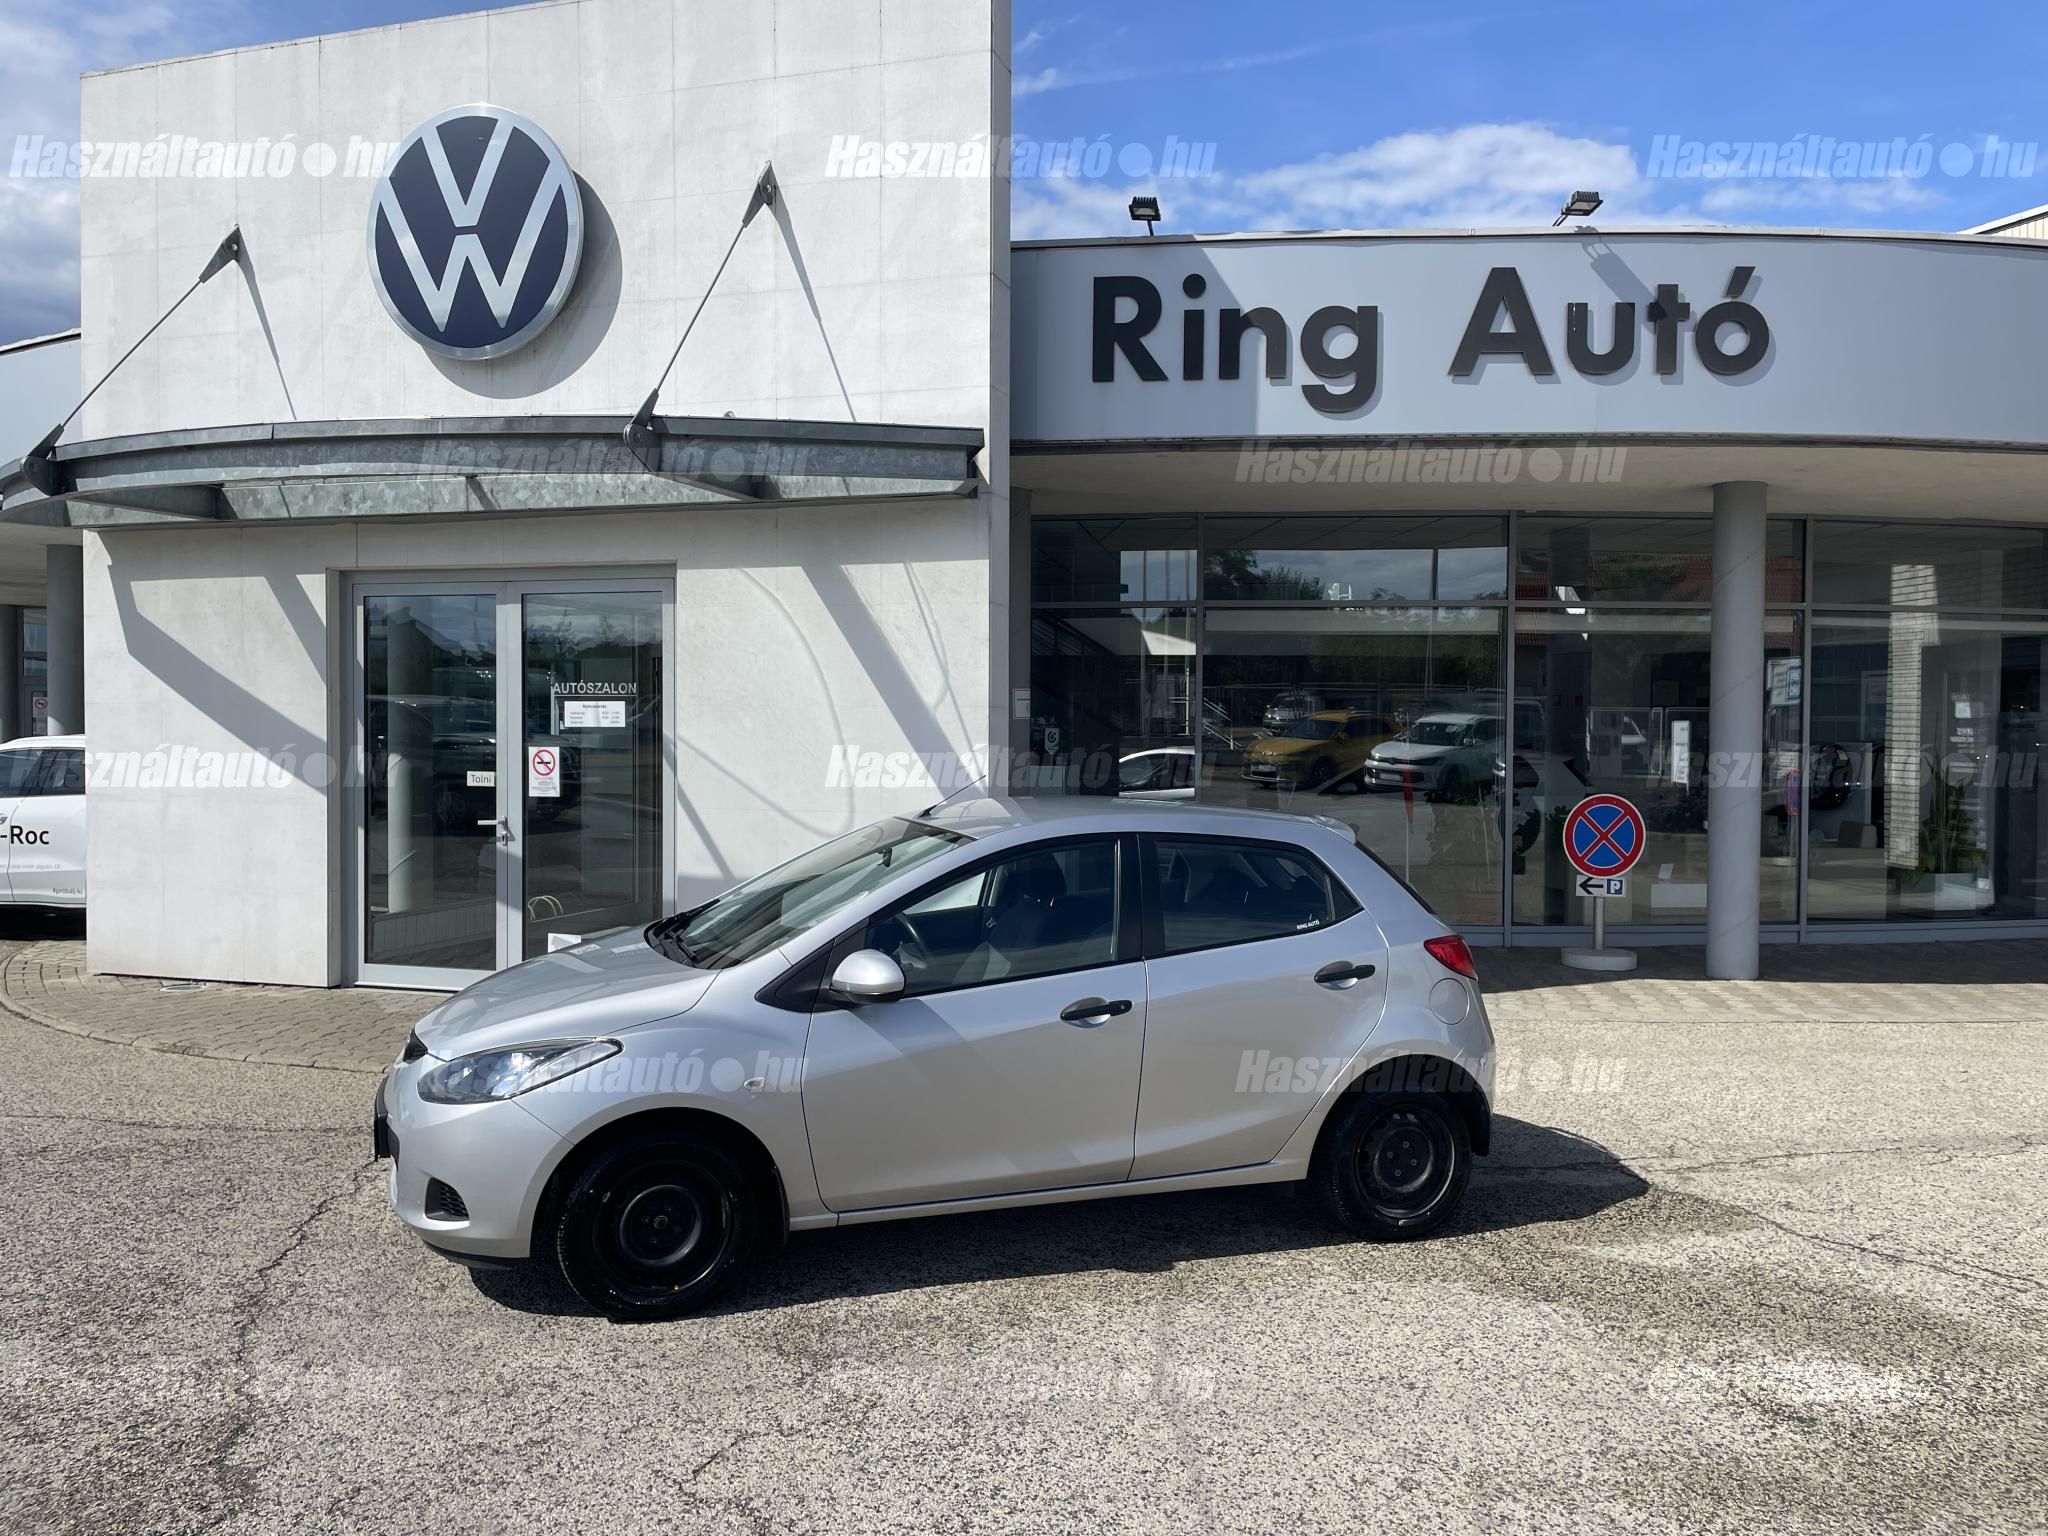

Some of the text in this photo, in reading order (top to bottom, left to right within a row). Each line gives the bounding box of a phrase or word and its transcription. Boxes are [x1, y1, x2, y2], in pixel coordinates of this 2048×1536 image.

[1092, 266, 1770, 413] Ring Autó
[553, 680, 637, 694] AUTÓSZALON
[471, 773, 492, 784] Tolni
